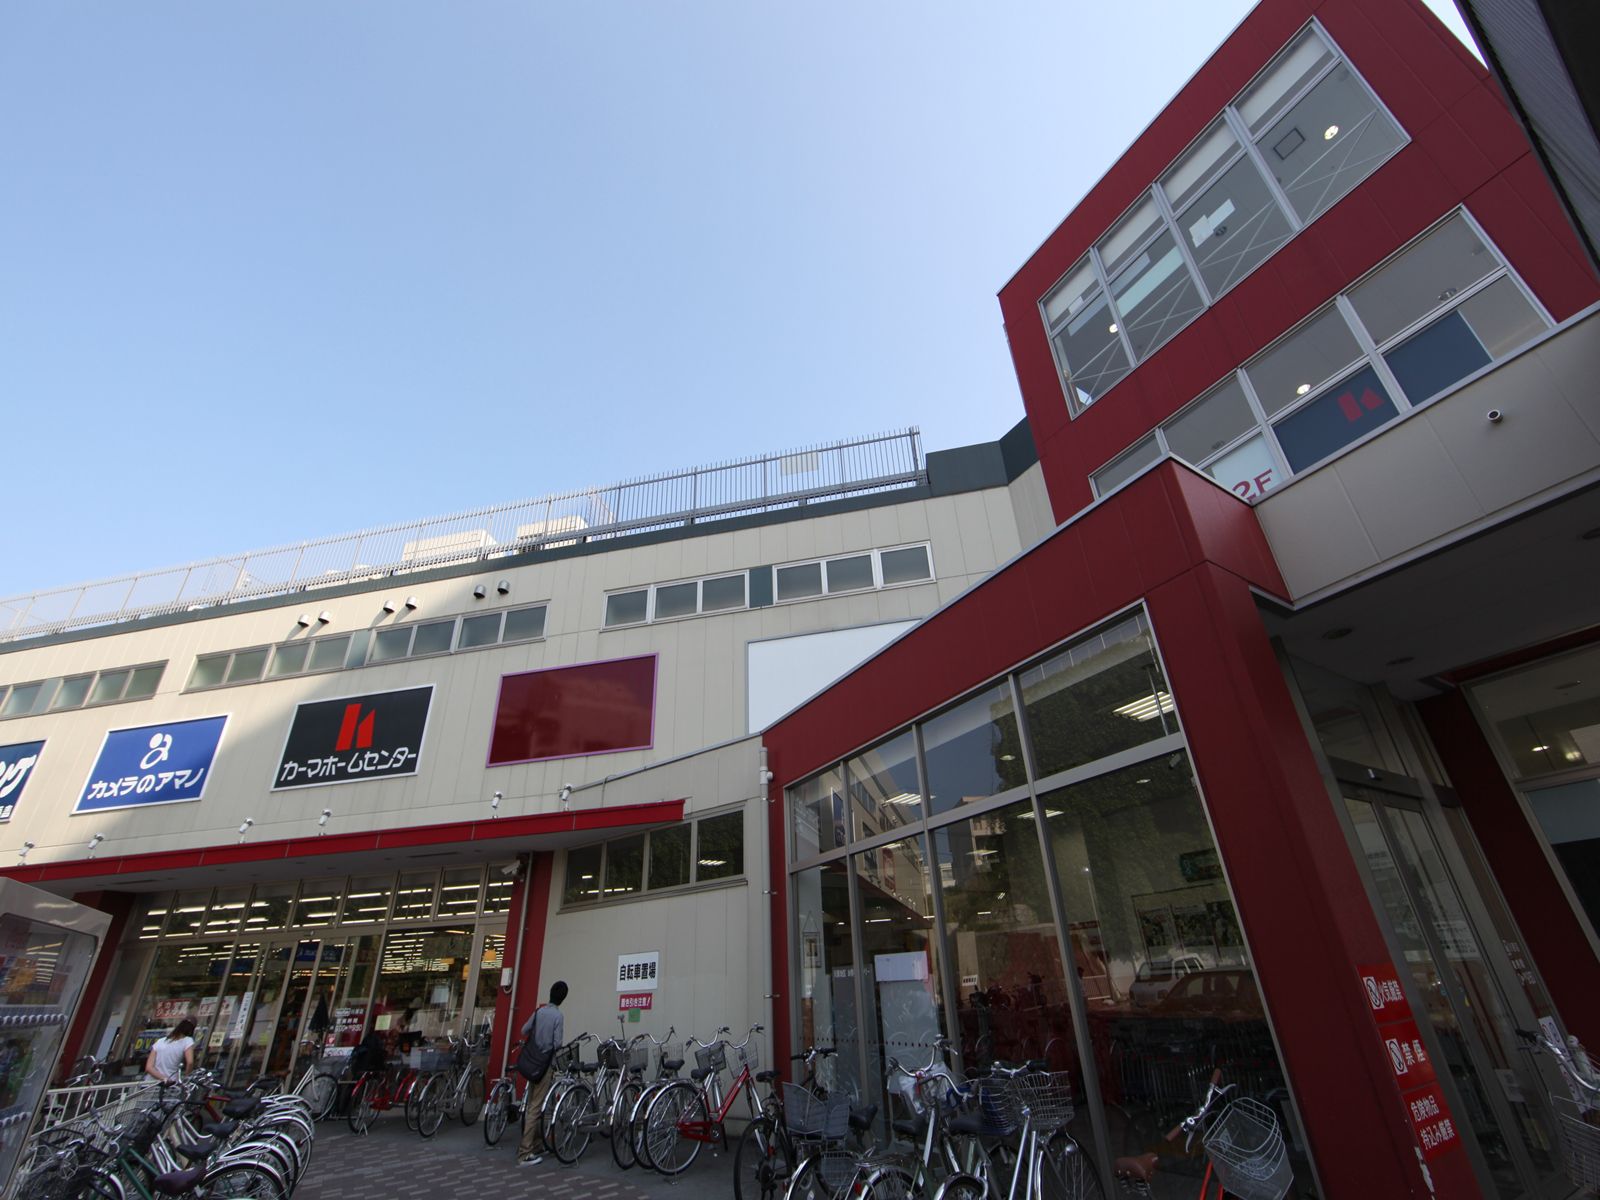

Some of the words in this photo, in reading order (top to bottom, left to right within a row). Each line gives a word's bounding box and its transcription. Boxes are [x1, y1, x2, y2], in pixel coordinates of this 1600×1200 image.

[1232, 469, 1272, 502] 2F
[280, 746, 417, 782] カーマホームセンター
[87, 767, 204, 800] カメラのアマノ
[620, 962, 657, 981] 自転車置場
[1410, 1095, 1440, 1123] 危険物品
